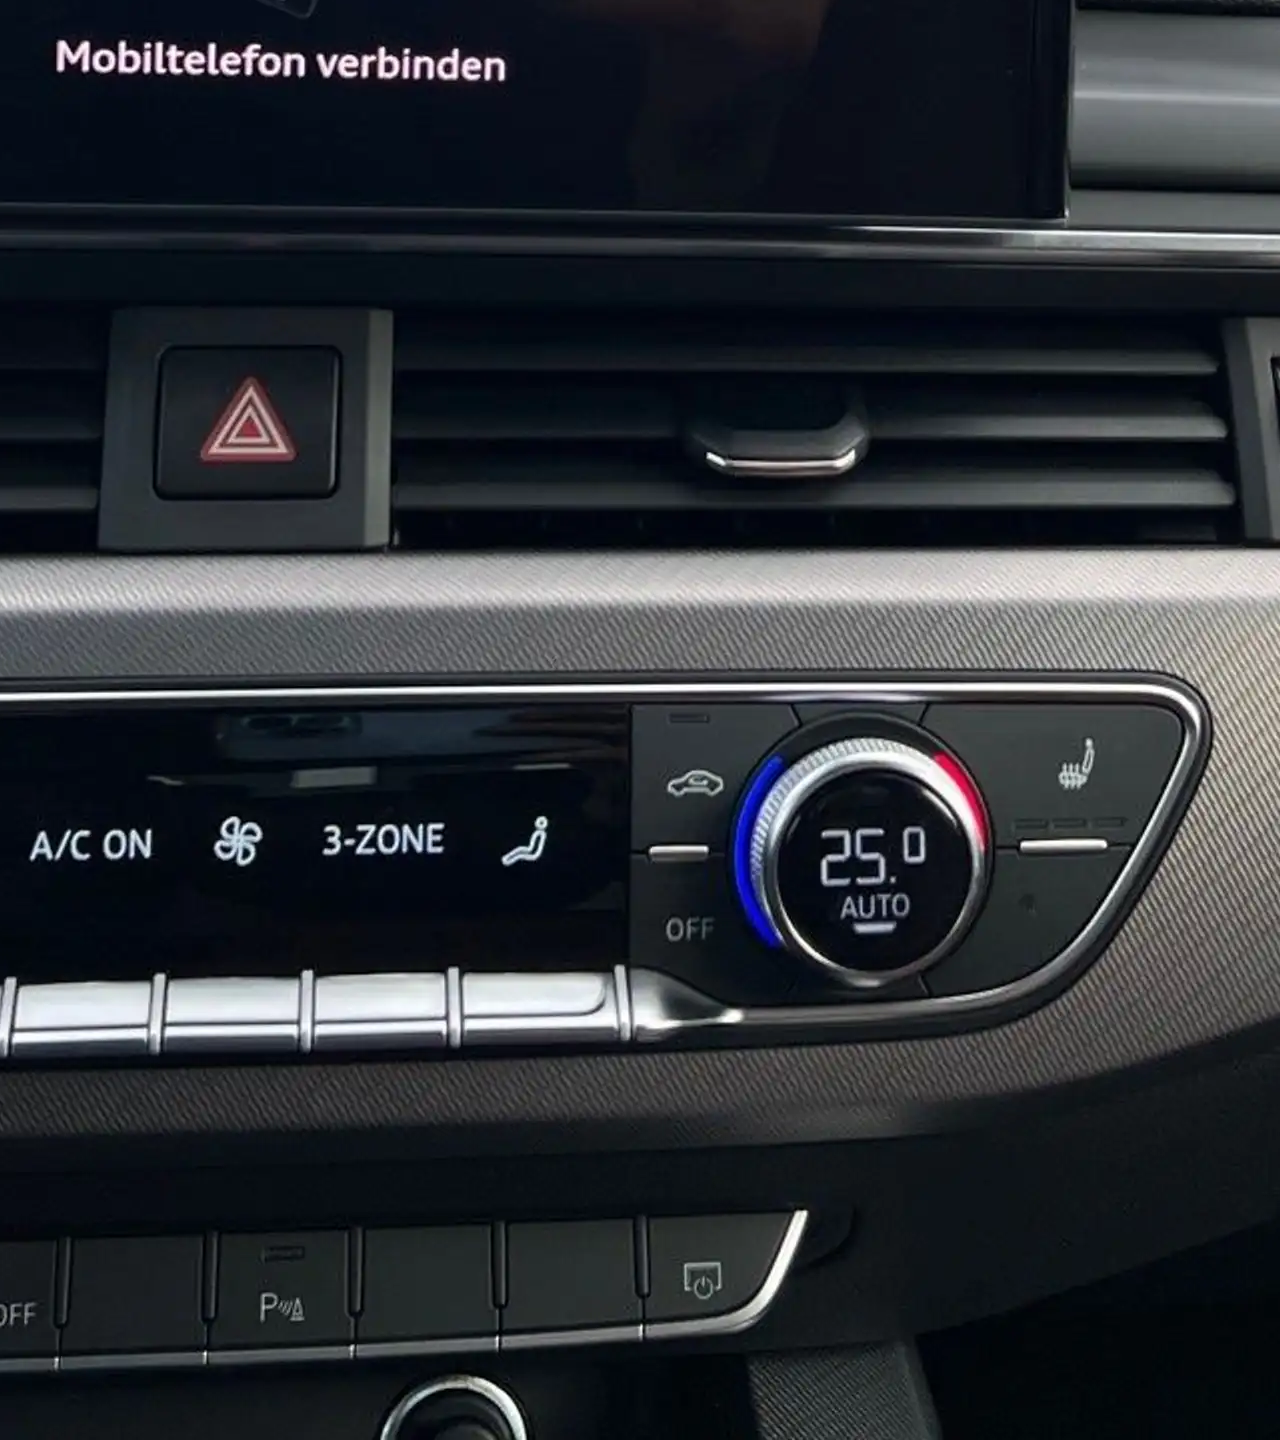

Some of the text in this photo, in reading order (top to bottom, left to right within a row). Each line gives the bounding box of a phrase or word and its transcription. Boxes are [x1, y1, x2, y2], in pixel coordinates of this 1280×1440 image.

[56, 39, 506, 82] Mobiltelefon verbinden
[29, 828, 153, 861] A/C ON
[322, 822, 445, 856] 3-ZONE
[840, 893, 910, 919] AUTO
[666, 918, 714, 941] OFF
